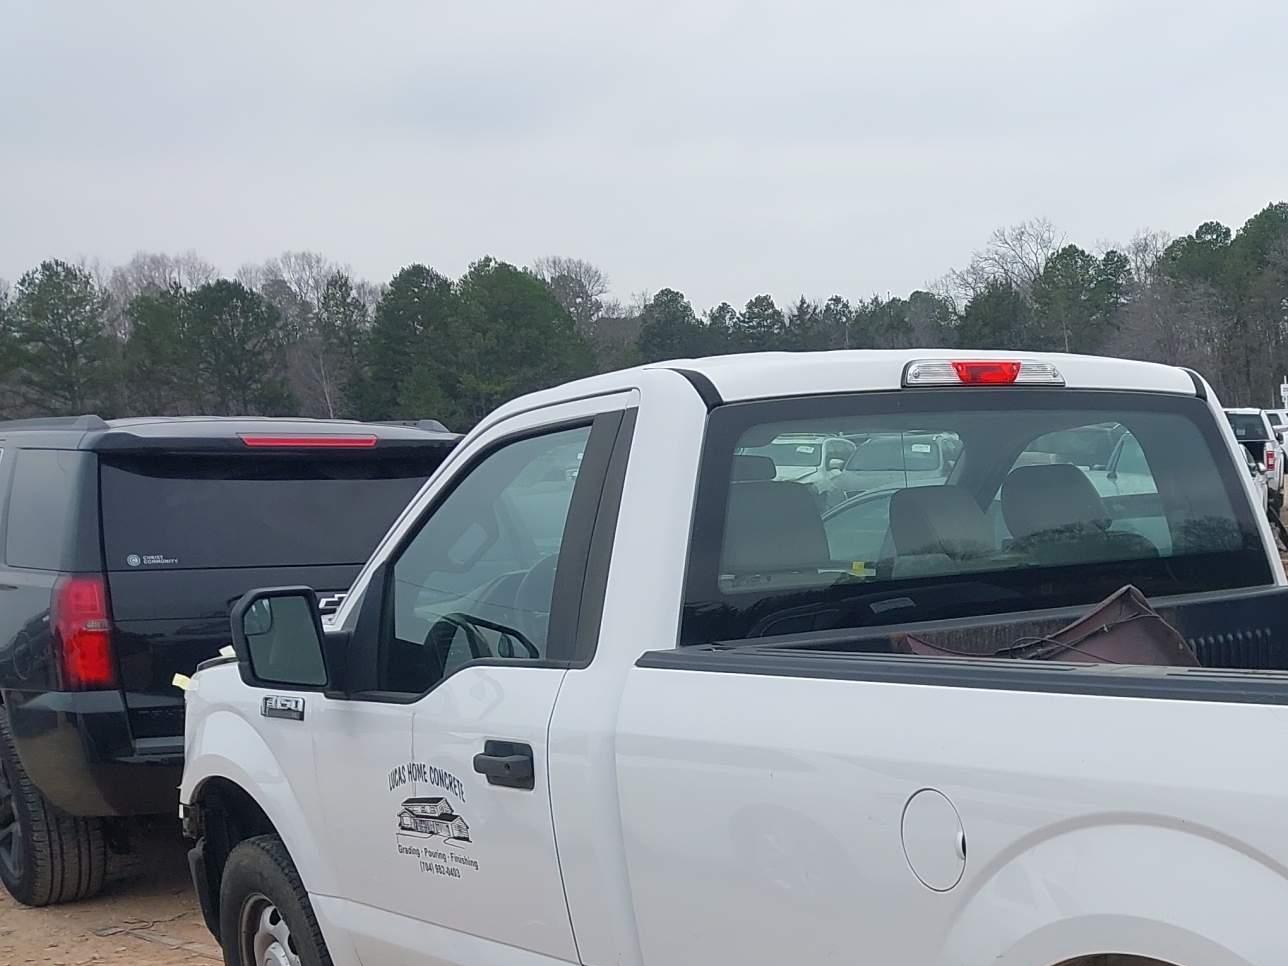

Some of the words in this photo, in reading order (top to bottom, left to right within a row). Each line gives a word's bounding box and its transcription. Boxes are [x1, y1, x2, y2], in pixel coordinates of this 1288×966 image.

[388, 765, 407, 791] LUCAS
[407, 762, 428, 783] HOME
[429, 765, 466, 803] CONCRETE
[398, 844, 421, 858] Grading
[424, 847, 448, 863] Pouring
[449, 852, 479, 871] Finishing
